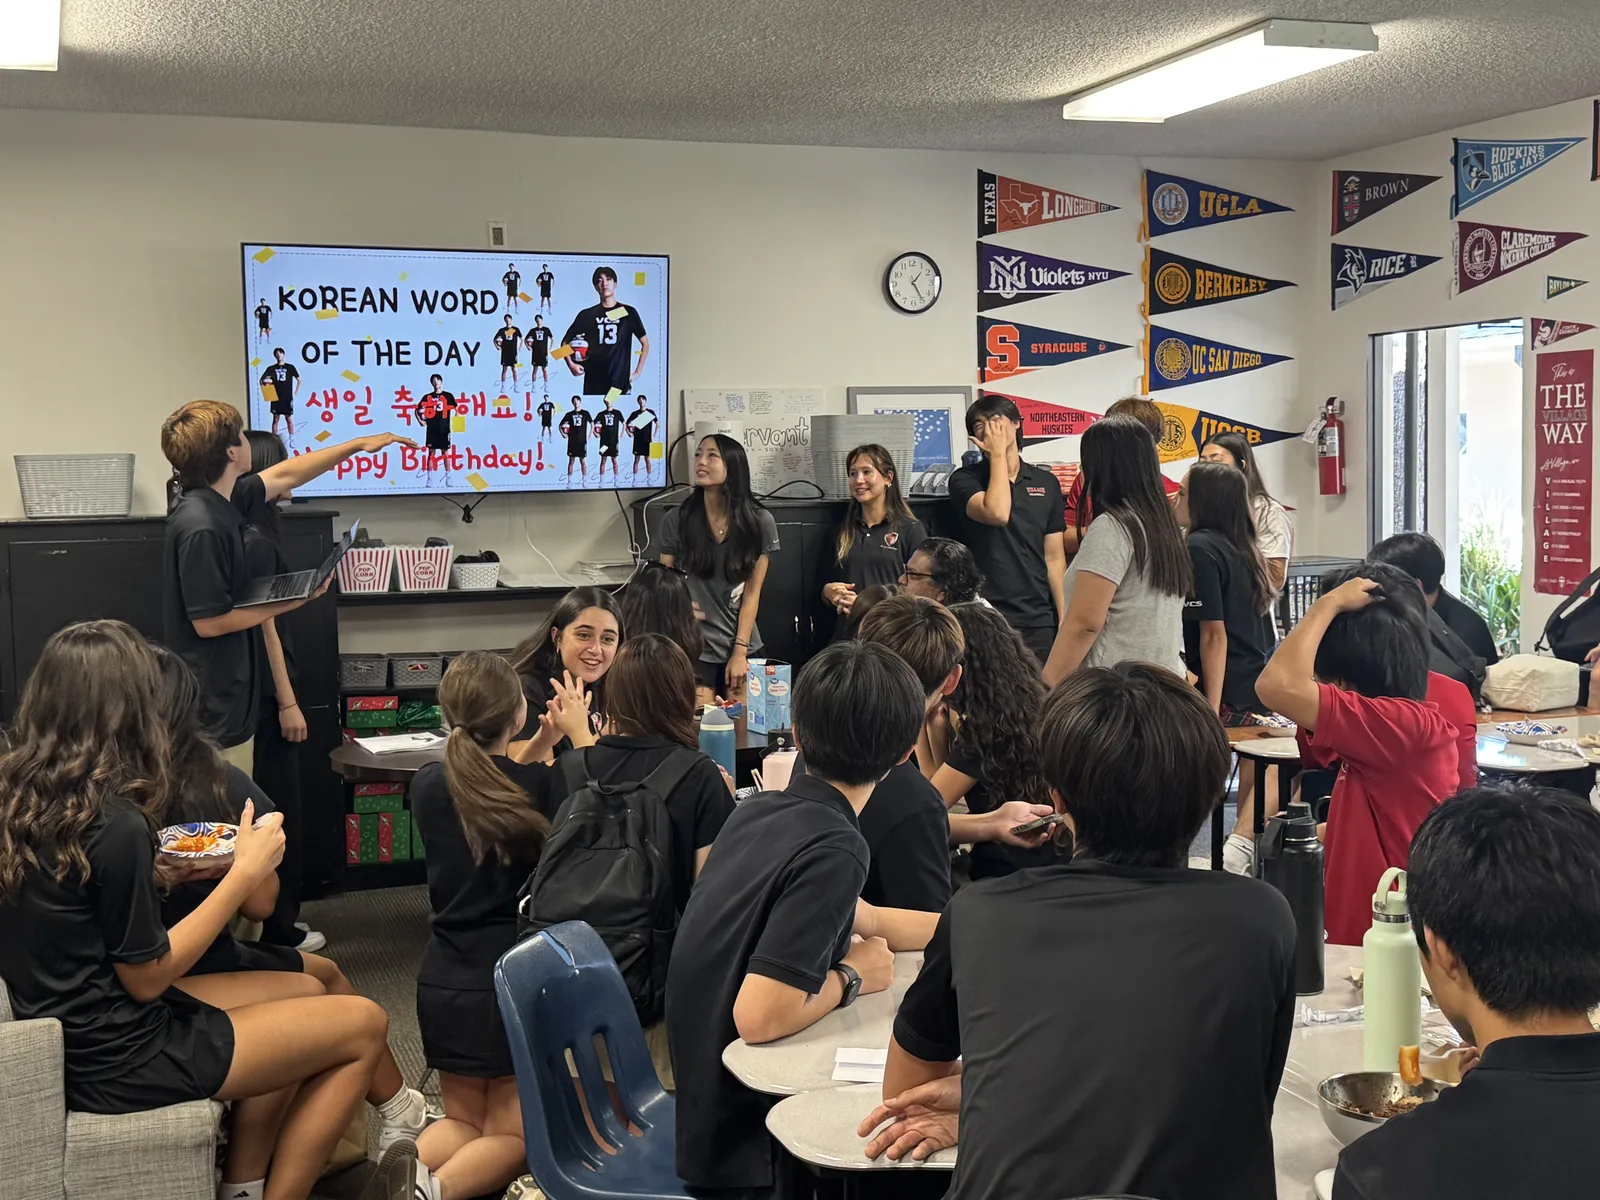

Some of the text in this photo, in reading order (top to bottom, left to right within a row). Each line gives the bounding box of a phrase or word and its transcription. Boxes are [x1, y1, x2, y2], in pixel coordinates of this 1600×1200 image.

[1491, 145, 1545, 165] HOPKINS
[1492, 153, 1545, 183] BLUE JAYS
[1365, 179, 1409, 201] BROWN
[984, 183, 996, 225] TEXAS
[1042, 191, 1097, 220] LONGHORNS
[1200, 190, 1264, 218] UCLA
[1501, 230, 1556, 251] CLAREMONT
[1530, 241, 1556, 258] COLLEGE
[1369, 253, 1407, 278] RICE
[1030, 267, 1109, 287] Violets NYU
[1195, 268, 1267, 300] BERKELEY
[279, 285, 499, 315] KOREAN WORD
[597, 324, 618, 345] 13
[301, 339, 481, 367] OF THE DAY
[1031, 342, 1088, 354] SYRACUSE
[1192, 344, 1206, 375] UC
[1208, 347, 1230, 372] SAN
[1232, 351, 1263, 369] DIEGO
[305, 385, 374, 426] 생일
[1540, 382, 1586, 409] THE
[1030, 412, 1085, 422] NORTHEASTERN
[1542, 408, 1587, 422] VILLAGE
[744, 416, 809, 447] rvant
[1041, 424, 1073, 434] HUSKIES
[1542, 422, 1588, 445] WAY
[293, 441, 545, 480] ppy Birthday!
[1545, 477, 1551, 485] V
[1545, 503, 1551, 511] L
[1545, 516, 1550, 524] L
[1543, 529, 1550, 537] A
[1543, 541, 1550, 550] G
[1543, 555, 1549, 563] E
[1183, 600, 1203, 608] VCS
